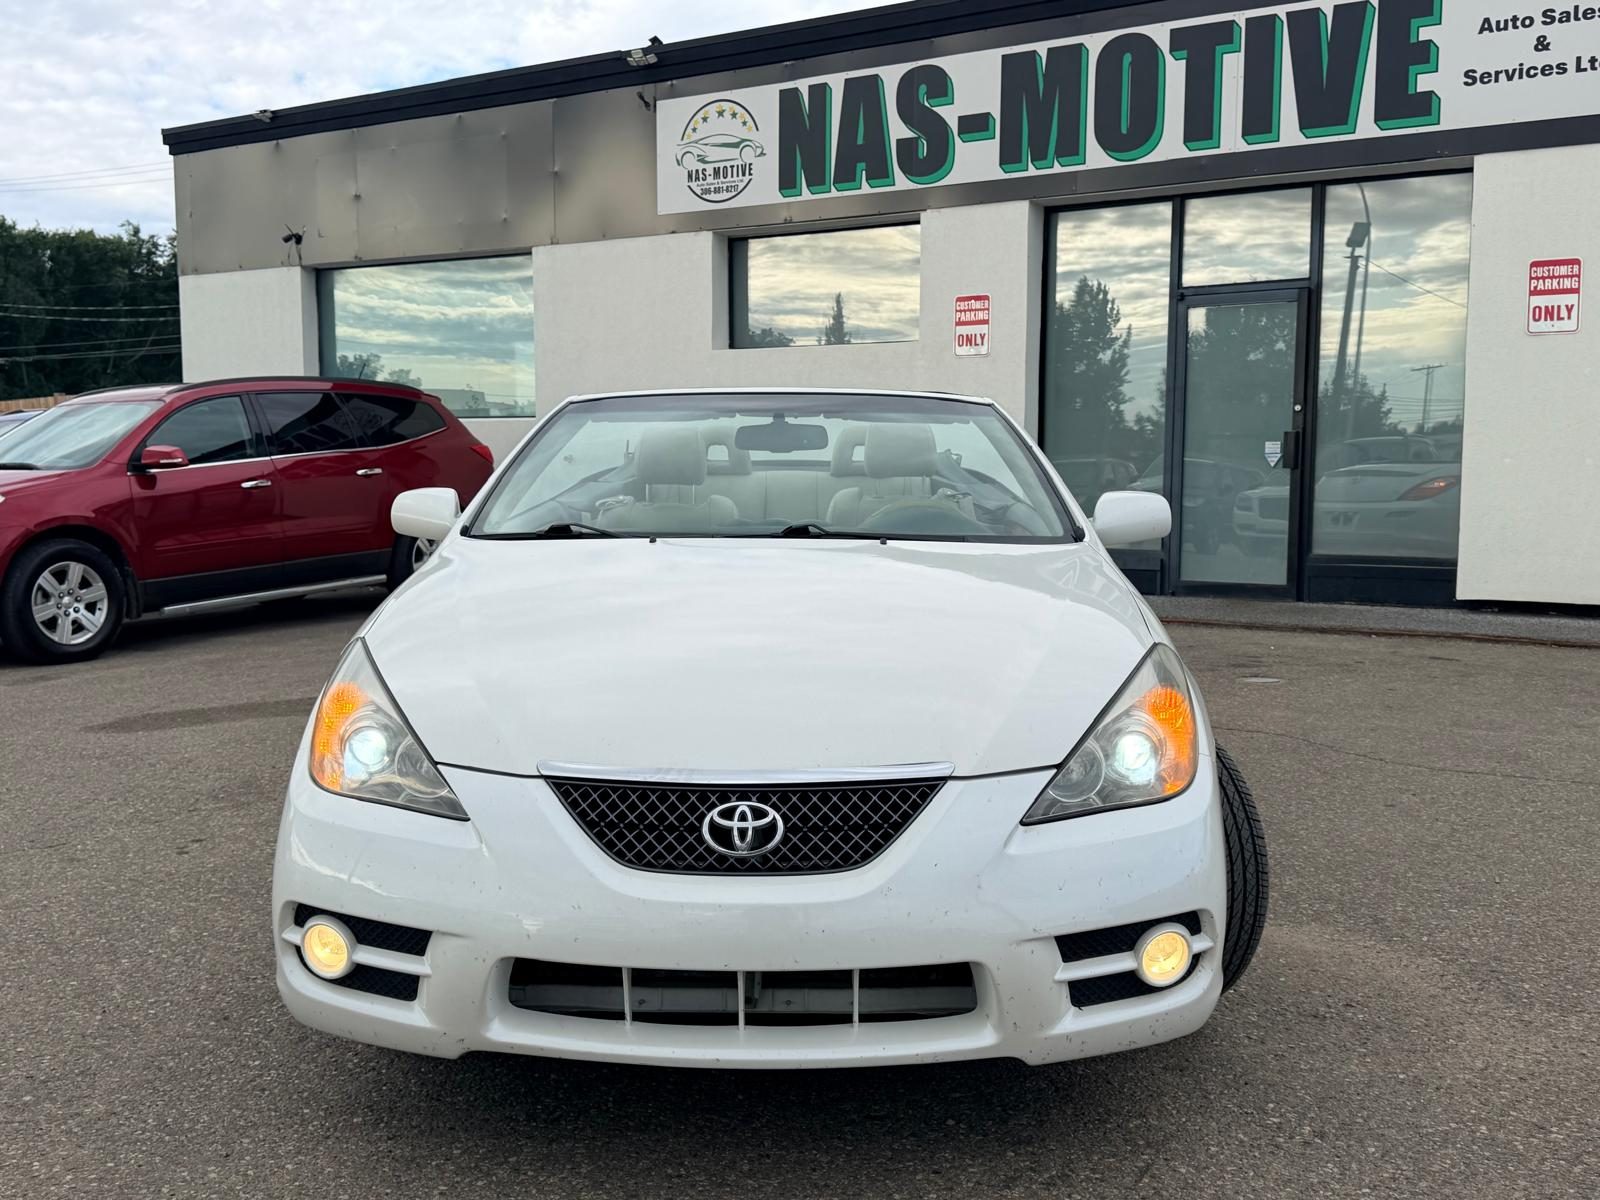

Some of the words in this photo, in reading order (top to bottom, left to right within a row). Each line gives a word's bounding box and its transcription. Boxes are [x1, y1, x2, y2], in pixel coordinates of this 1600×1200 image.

[1478, 15, 1535, 34] Auto
[1541, 5, 1600, 26] Sale
[1534, 35, 1551, 52] &
[1463, 63, 1568, 87] Services
[1575, 55, 1600, 73] Lt
[779, 0, 1442, 198] NAS-MOTIVE
[687, 162, 753, 183] NAS-MOTIVE
[1531, 265, 1579, 277] CUSTOMER
[1530, 277, 1579, 291] PARKING
[956, 300, 989, 310] CUSTOMER
[1532, 304, 1575, 322] ONLY
[956, 310, 989, 322] PARKING
[957, 333, 986, 347] ONLY
